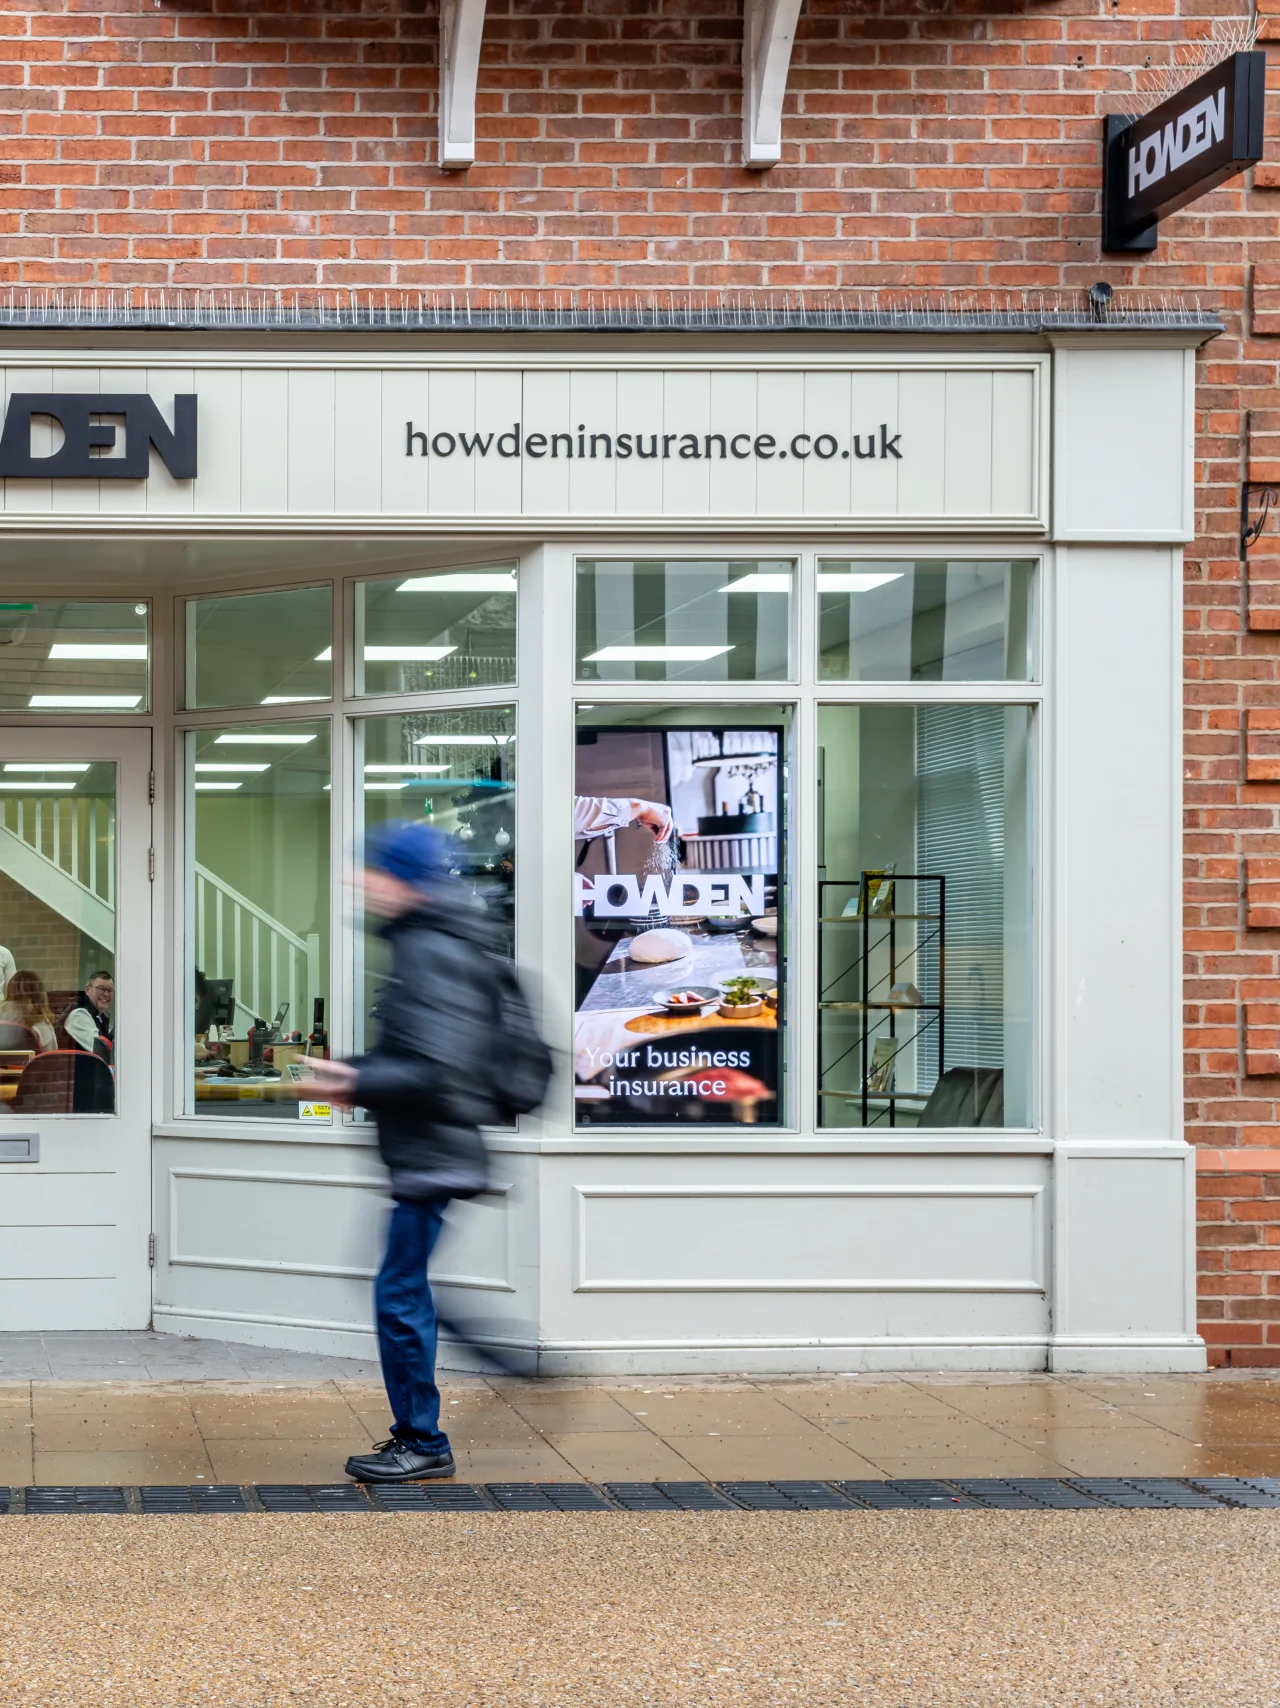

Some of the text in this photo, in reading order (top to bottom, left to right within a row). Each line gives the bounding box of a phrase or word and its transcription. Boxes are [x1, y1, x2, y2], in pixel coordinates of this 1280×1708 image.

[1127, 86, 1226, 199] HOWDEN
[406, 421, 904, 459] howdeninsurance.co.uk
[574, 874, 765, 916] HOWDEN
[584, 1045, 751, 1068] Your business
[609, 1075, 727, 1097] insurance
